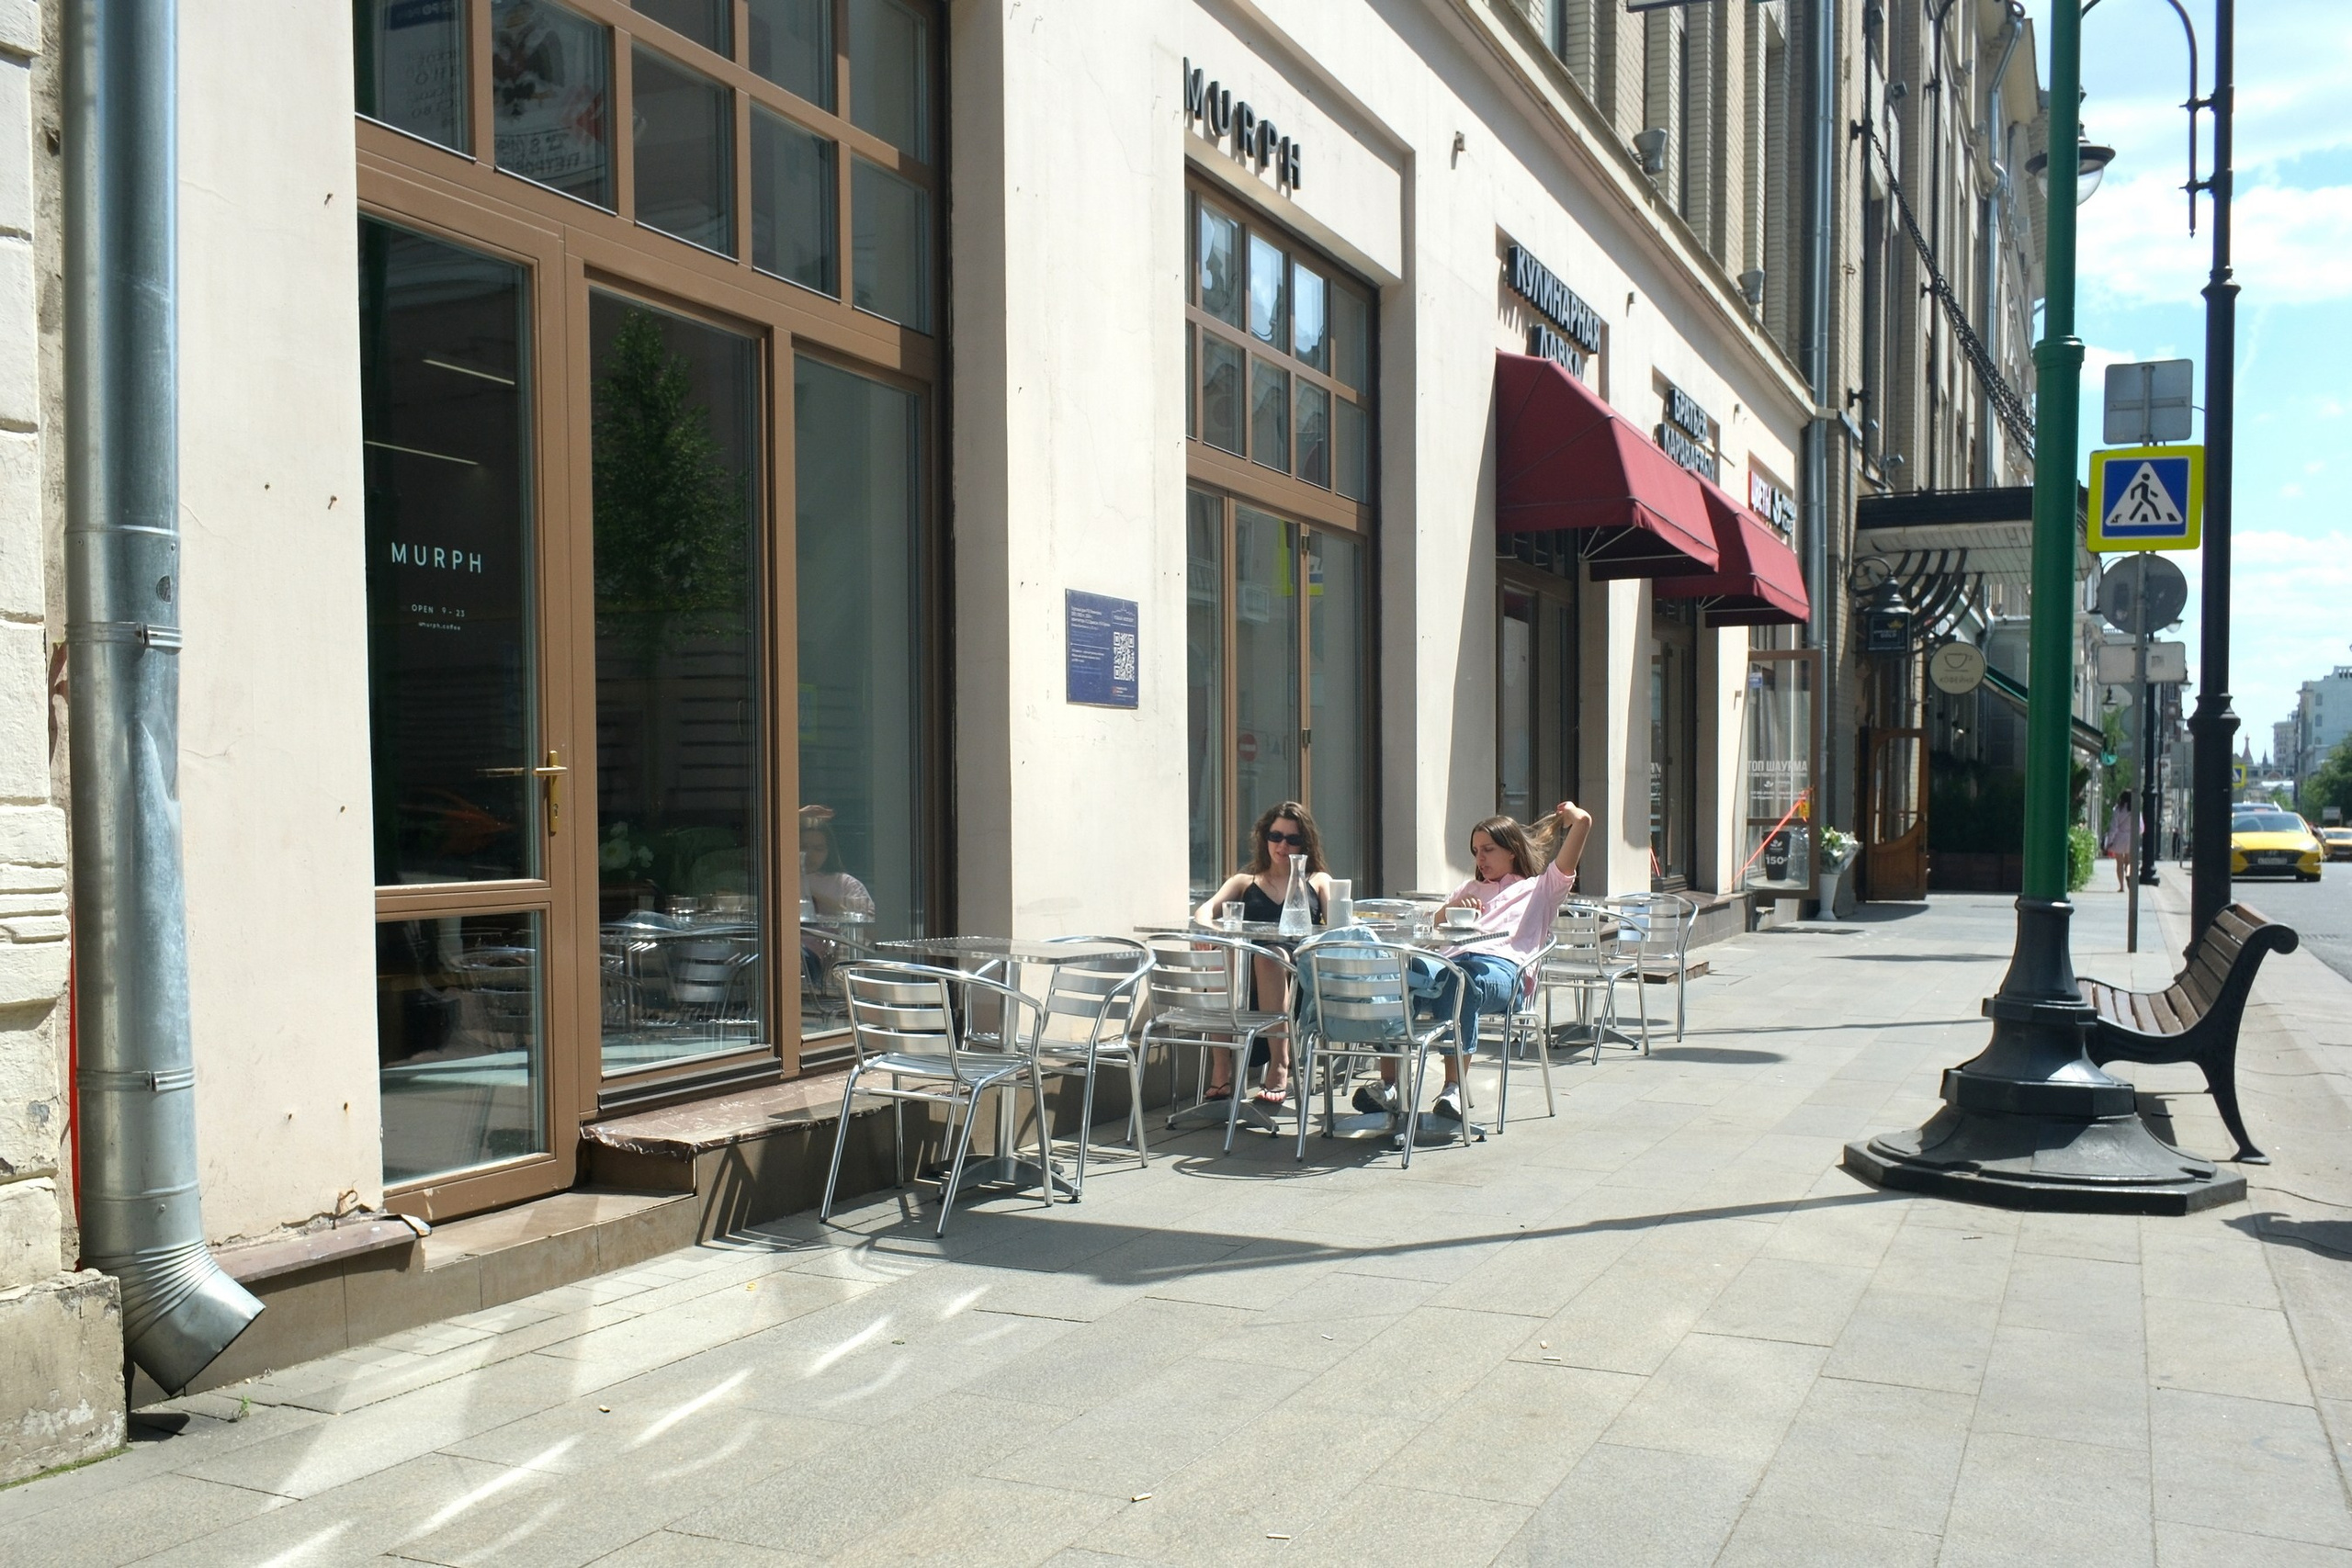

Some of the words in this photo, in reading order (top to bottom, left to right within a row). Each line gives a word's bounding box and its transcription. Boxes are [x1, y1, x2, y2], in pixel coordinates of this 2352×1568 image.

[1183, 57, 1301, 189] MURPH
[1512, 245, 1600, 354] КУЛИНАРНАЯ
[1537, 323, 1583, 380] ЛАВКА
[1672, 389, 1708, 442] БРАТЬЕВ
[391, 542, 481, 573] MURPH
[412, 604, 434, 614] OPEN
[1748, 760, 1764, 772] ТОП
[1766, 760, 1808, 772] ШАУРМА
